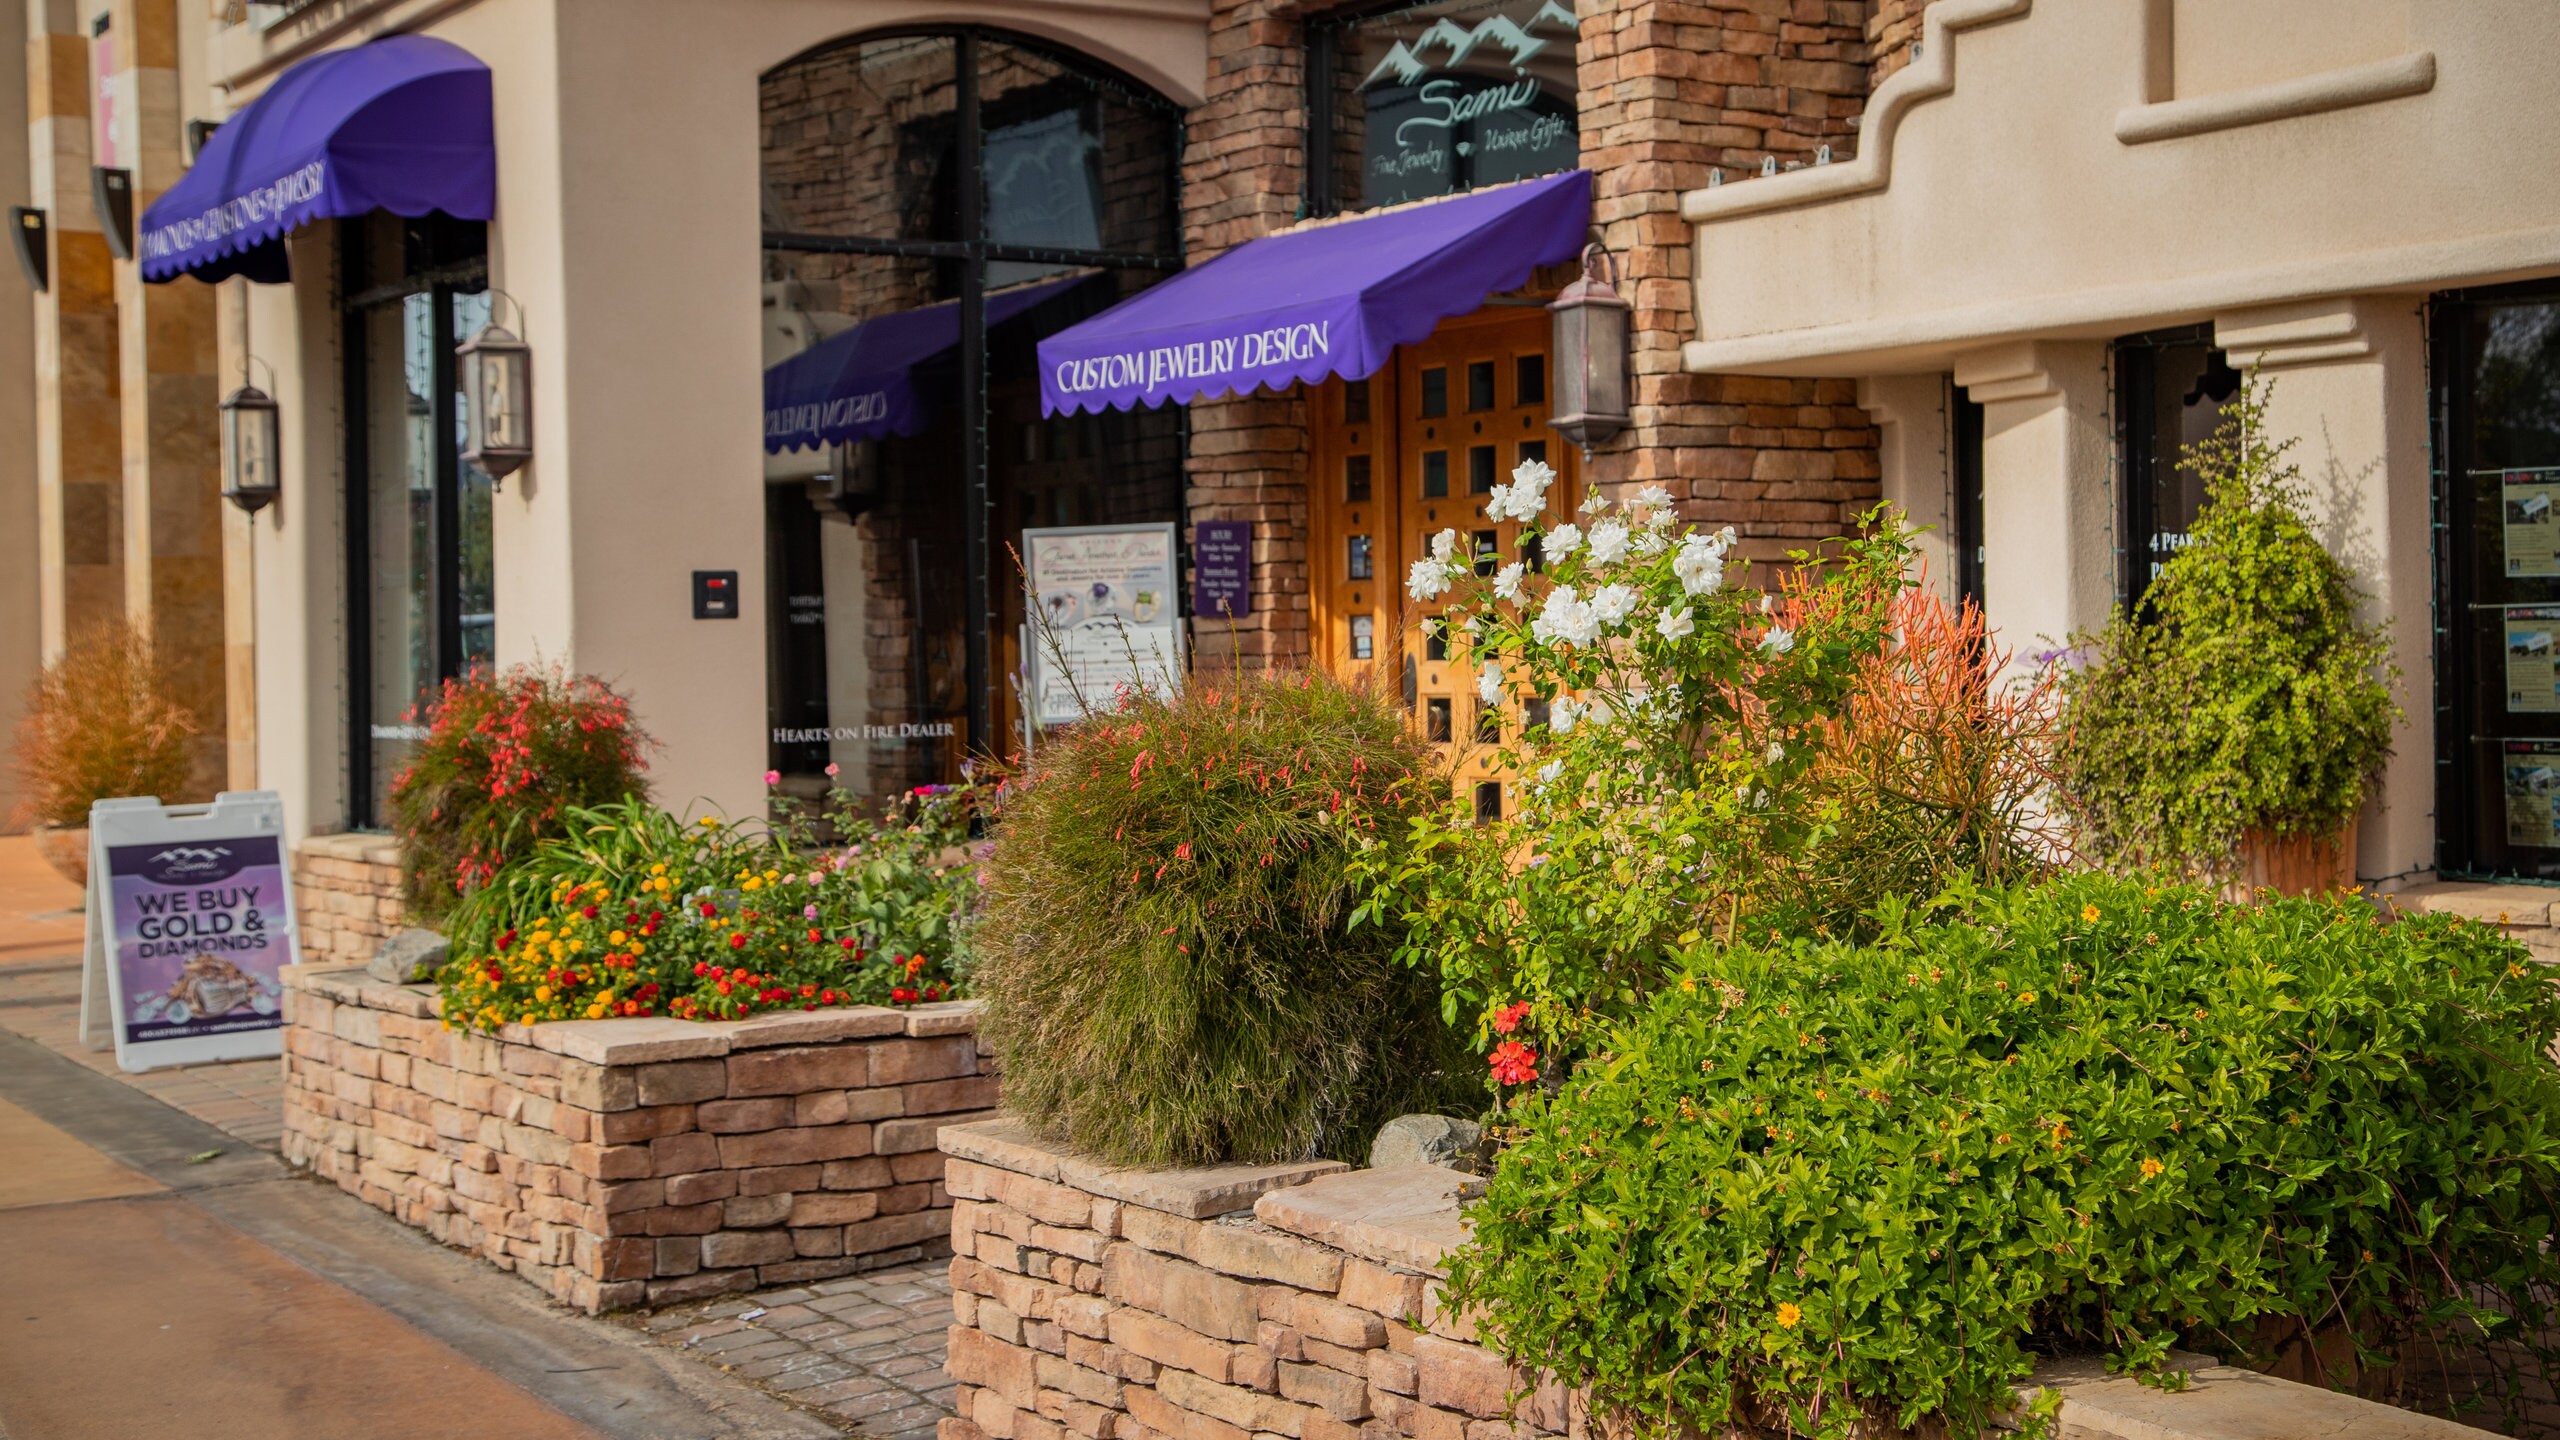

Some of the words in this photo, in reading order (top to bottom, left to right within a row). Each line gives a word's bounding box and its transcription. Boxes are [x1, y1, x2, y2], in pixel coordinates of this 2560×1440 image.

[1396, 66, 1534, 146] Sami
[1530, 112, 1565, 151] Gifts
[1056, 351, 1144, 393] CUSTOM
[1146, 336, 1238, 393] JEWELRY
[1242, 320, 1329, 369] DESIGN
[2149, 532, 2160, 552] 4
[2161, 531, 2196, 551] PEAK
[773, 728, 831, 744] HEARTS
[834, 726, 858, 741] ON
[863, 724, 895, 739] FIRE
[900, 722, 955, 738] DEALER
[135, 891, 189, 915] WE
[197, 885, 261, 911] BUY
[138, 911, 234, 940] GOLD
[244, 908, 265, 932] &
[138, 932, 268, 959] DIAMONDS
